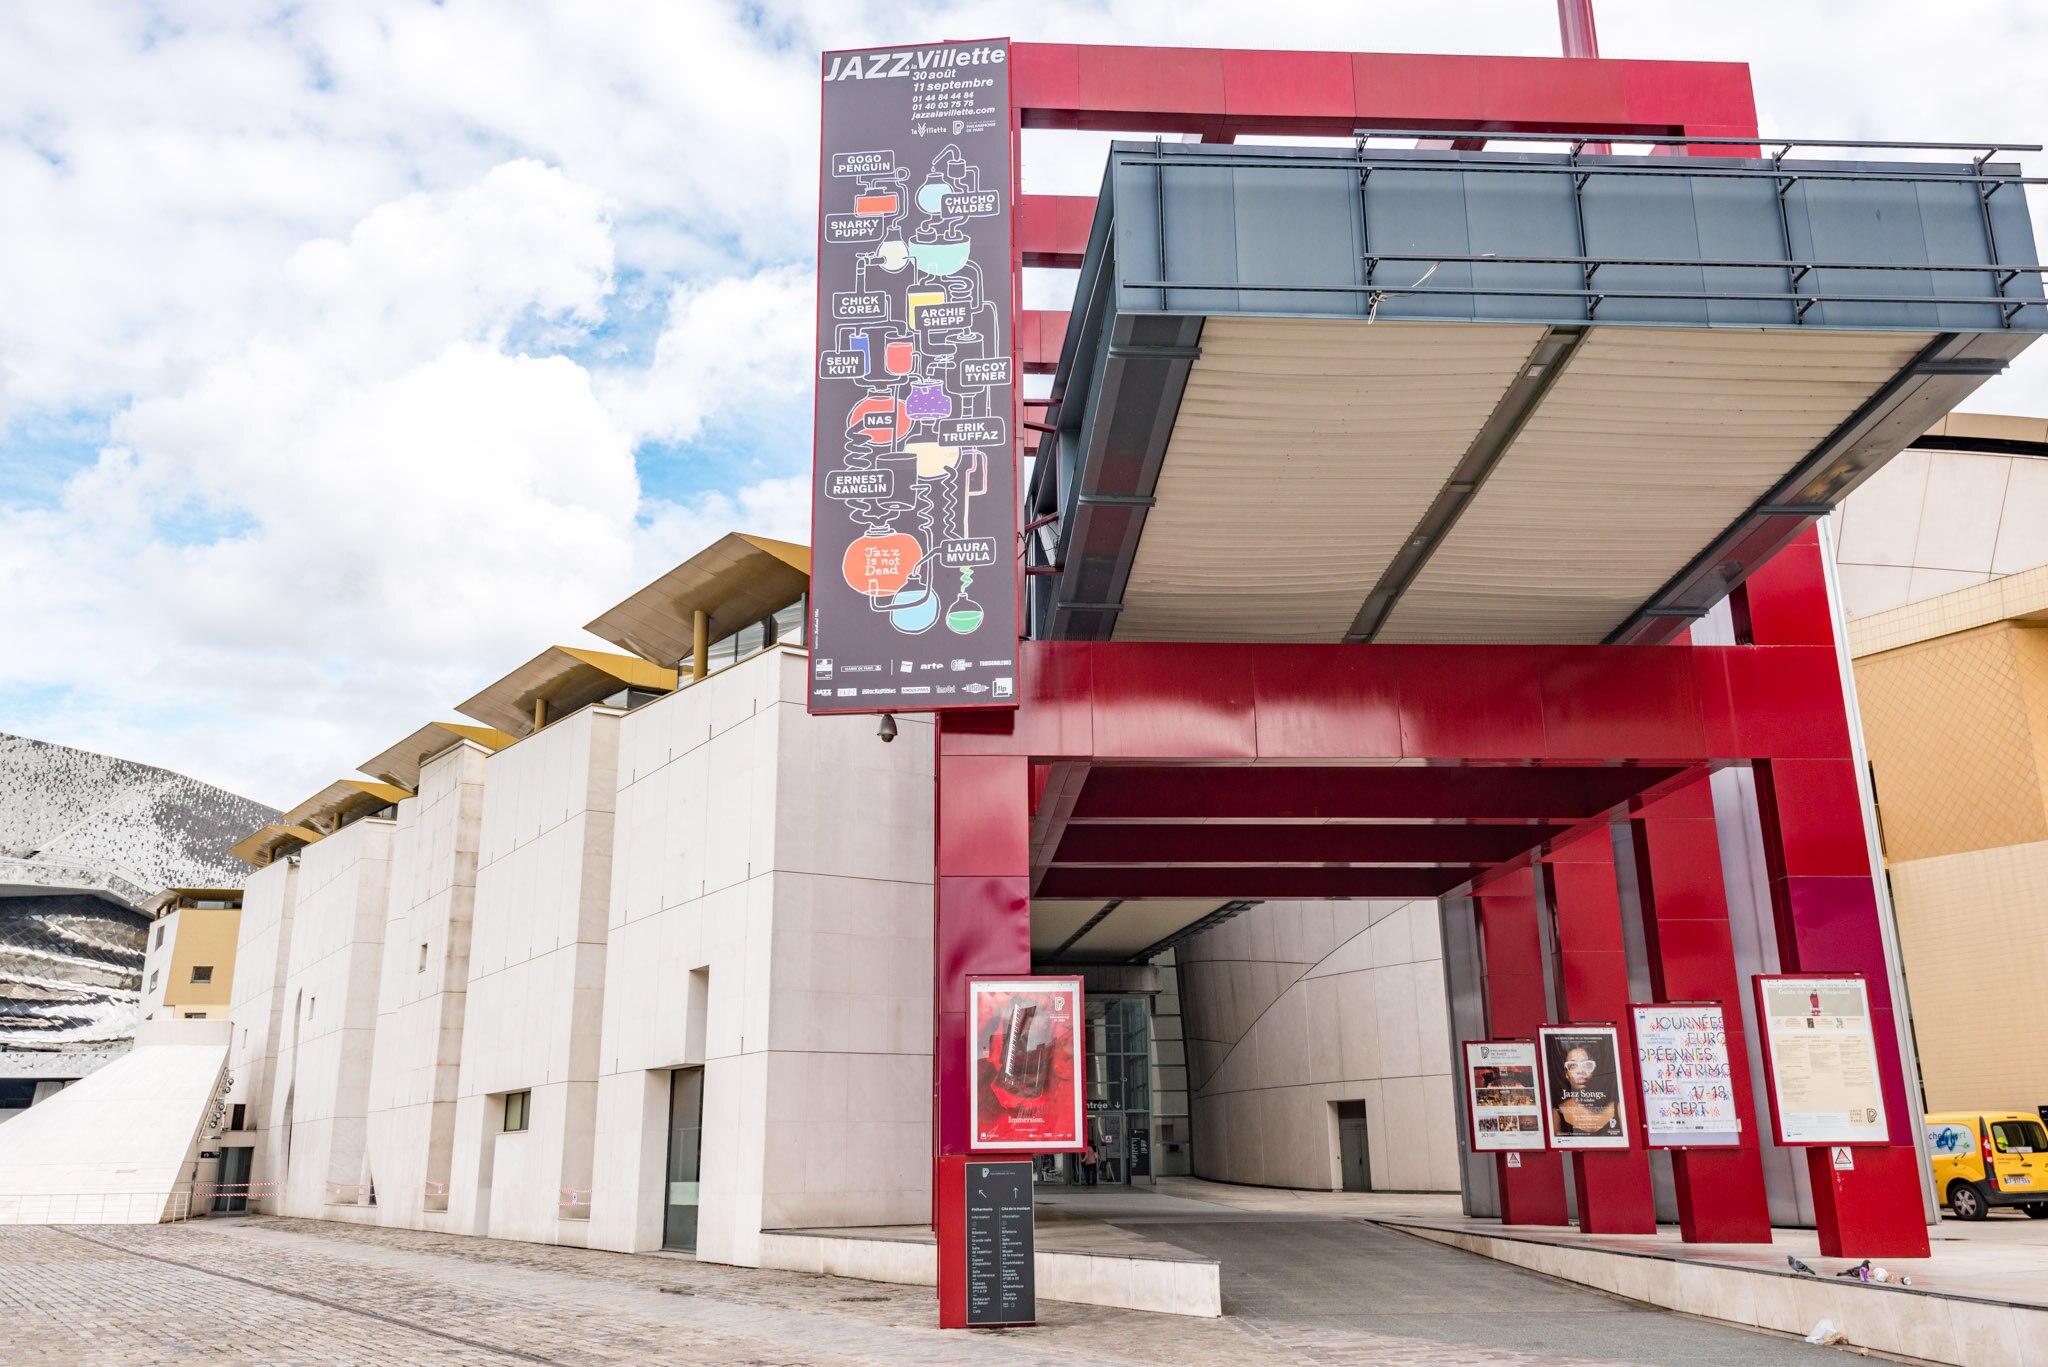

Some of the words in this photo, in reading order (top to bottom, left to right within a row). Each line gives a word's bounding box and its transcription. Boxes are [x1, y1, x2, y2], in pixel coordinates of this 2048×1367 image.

[824, 52, 914, 82] JAZZ
[917, 47, 1006, 70] Villette
[912, 71, 928, 80] 30
[928, 69, 956, 80] août
[913, 82, 924, 92] 11
[926, 78, 994, 93] septembre
[912, 95, 922, 103] 01
[911, 106, 996, 120] jazzalavillette.com
[848, 154, 882, 164] GOGO
[838, 162, 890, 173] PENGUIN
[944, 195, 996, 206] CHUCHO
[831, 220, 880, 230] SNARKY
[835, 228, 875, 238] PUPPY
[842, 296, 879, 306] CHICK
[840, 304, 880, 314] COREA
[921, 308, 966, 318] ARCHIE
[924, 316, 964, 326] SHEPP
[826, 356, 859, 366] SEUN
[829, 365, 856, 374] KUTI
[965, 362, 1007, 373] McCOY
[966, 372, 1006, 382] TYNER
[867, 416, 892, 425] NAS
[956, 422, 986, 432] ERIK
[943, 430, 998, 442] TRUFFAZ
[836, 474, 884, 486] ERNEST
[833, 484, 887, 495] RANGLIN
[864, 546, 900, 558] Jazz
[948, 542, 989, 553] LAURA
[881, 556, 900, 566] not
[946, 552, 990, 562] MVULA
[864, 564, 898, 576] Dead
[1562, 1089, 1580, 1100] Jazz
